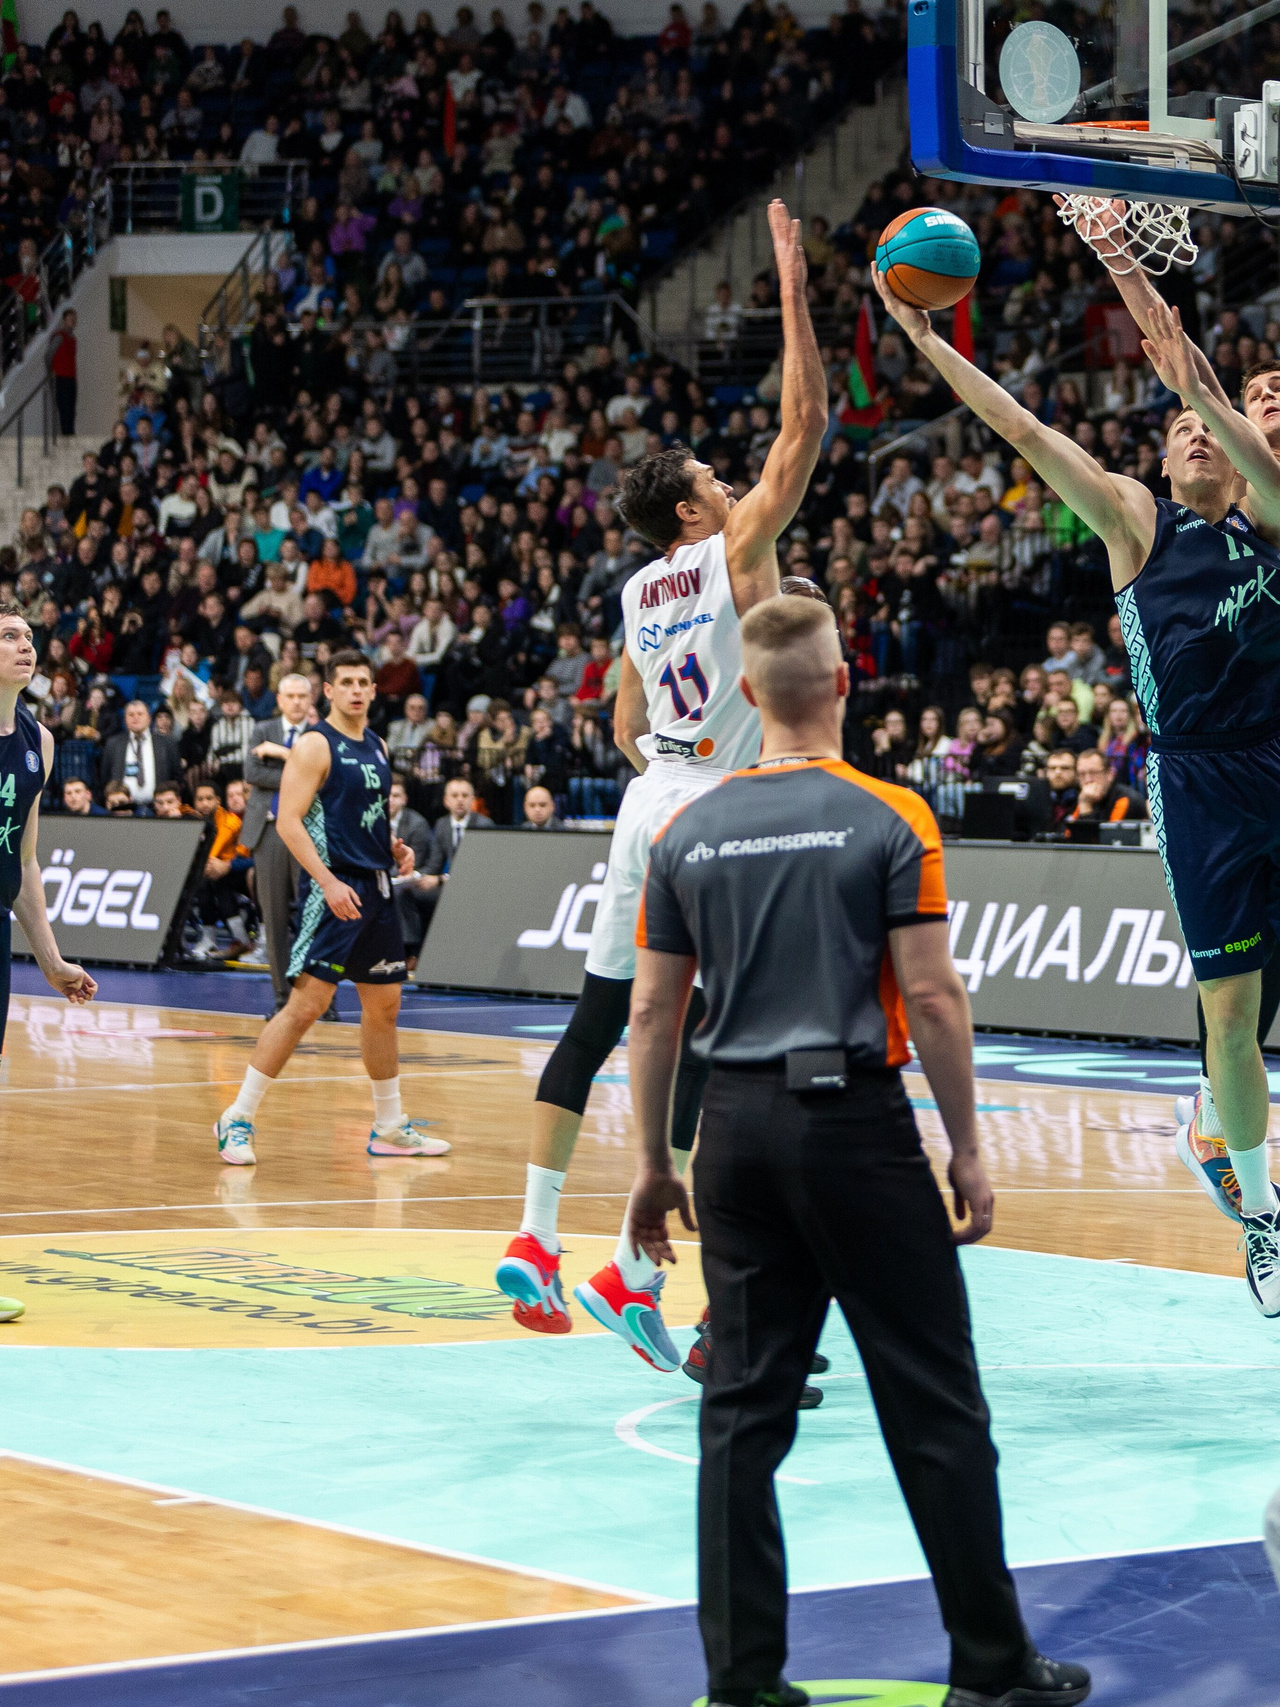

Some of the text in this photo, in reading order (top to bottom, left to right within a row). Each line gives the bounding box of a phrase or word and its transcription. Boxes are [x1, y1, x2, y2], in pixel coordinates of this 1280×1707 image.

[195, 186, 224, 222] D
[659, 652, 710, 721] 11
[360, 763, 381, 790] 15
[1191, 947, 1221, 958] Kempa
